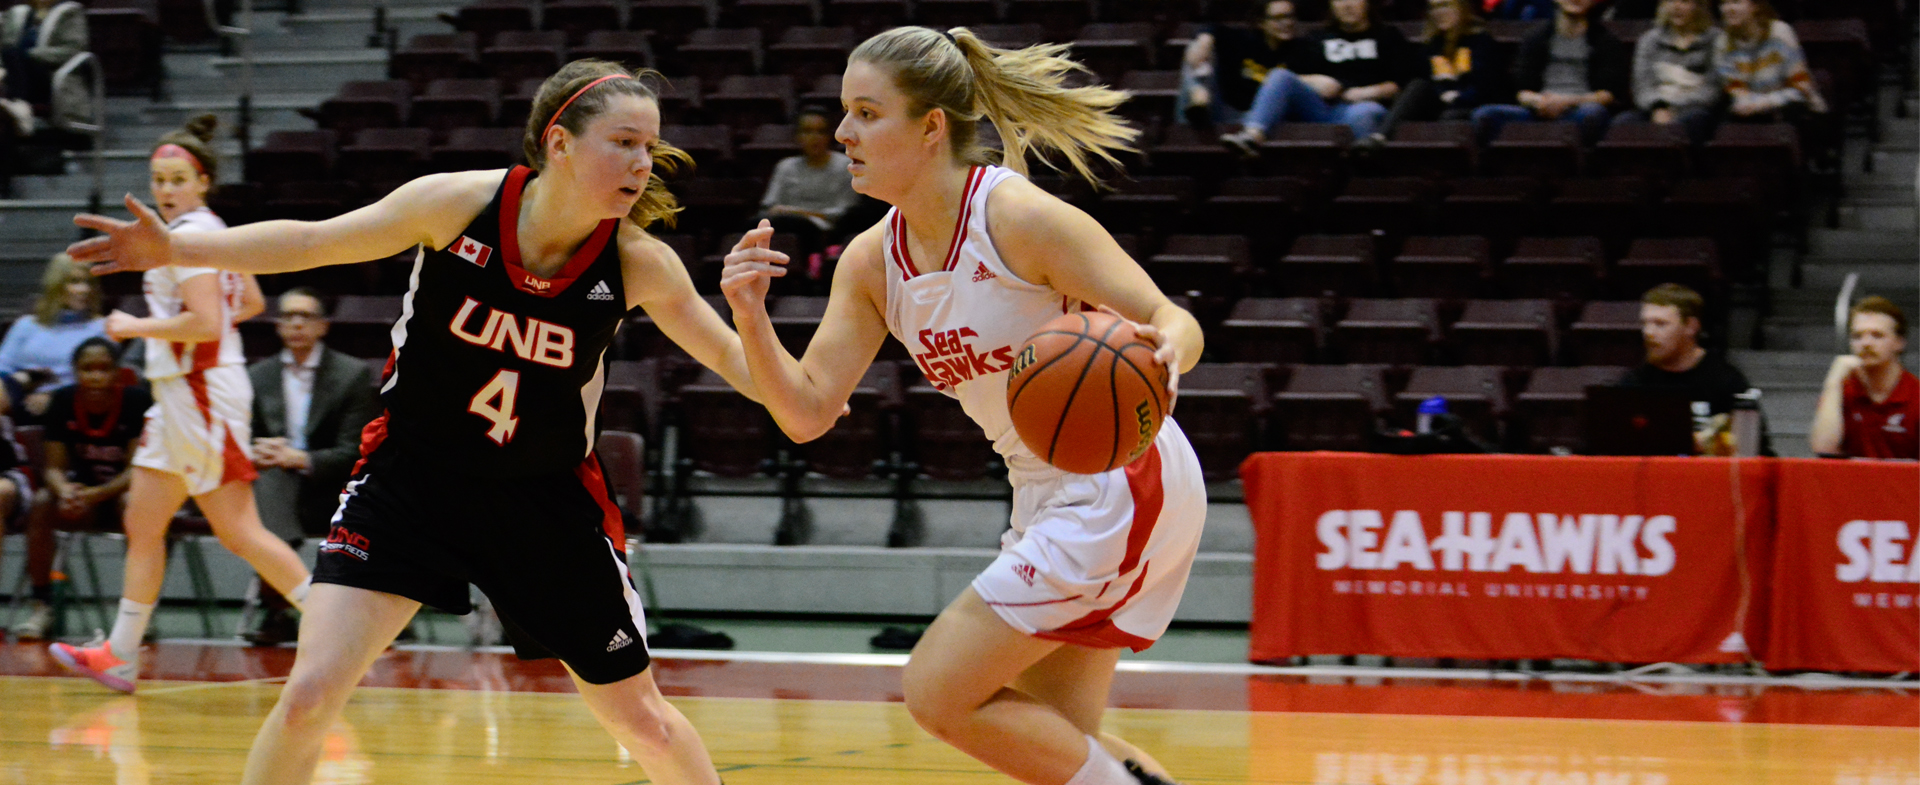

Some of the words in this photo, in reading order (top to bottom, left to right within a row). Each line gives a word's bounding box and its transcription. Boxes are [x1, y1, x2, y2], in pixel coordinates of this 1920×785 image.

[525, 275, 551, 290] UNB
[972, 272, 997, 282] adida
[449, 295, 576, 368] UNB
[467, 368, 520, 447] 4
[606, 637, 633, 653] adidas
